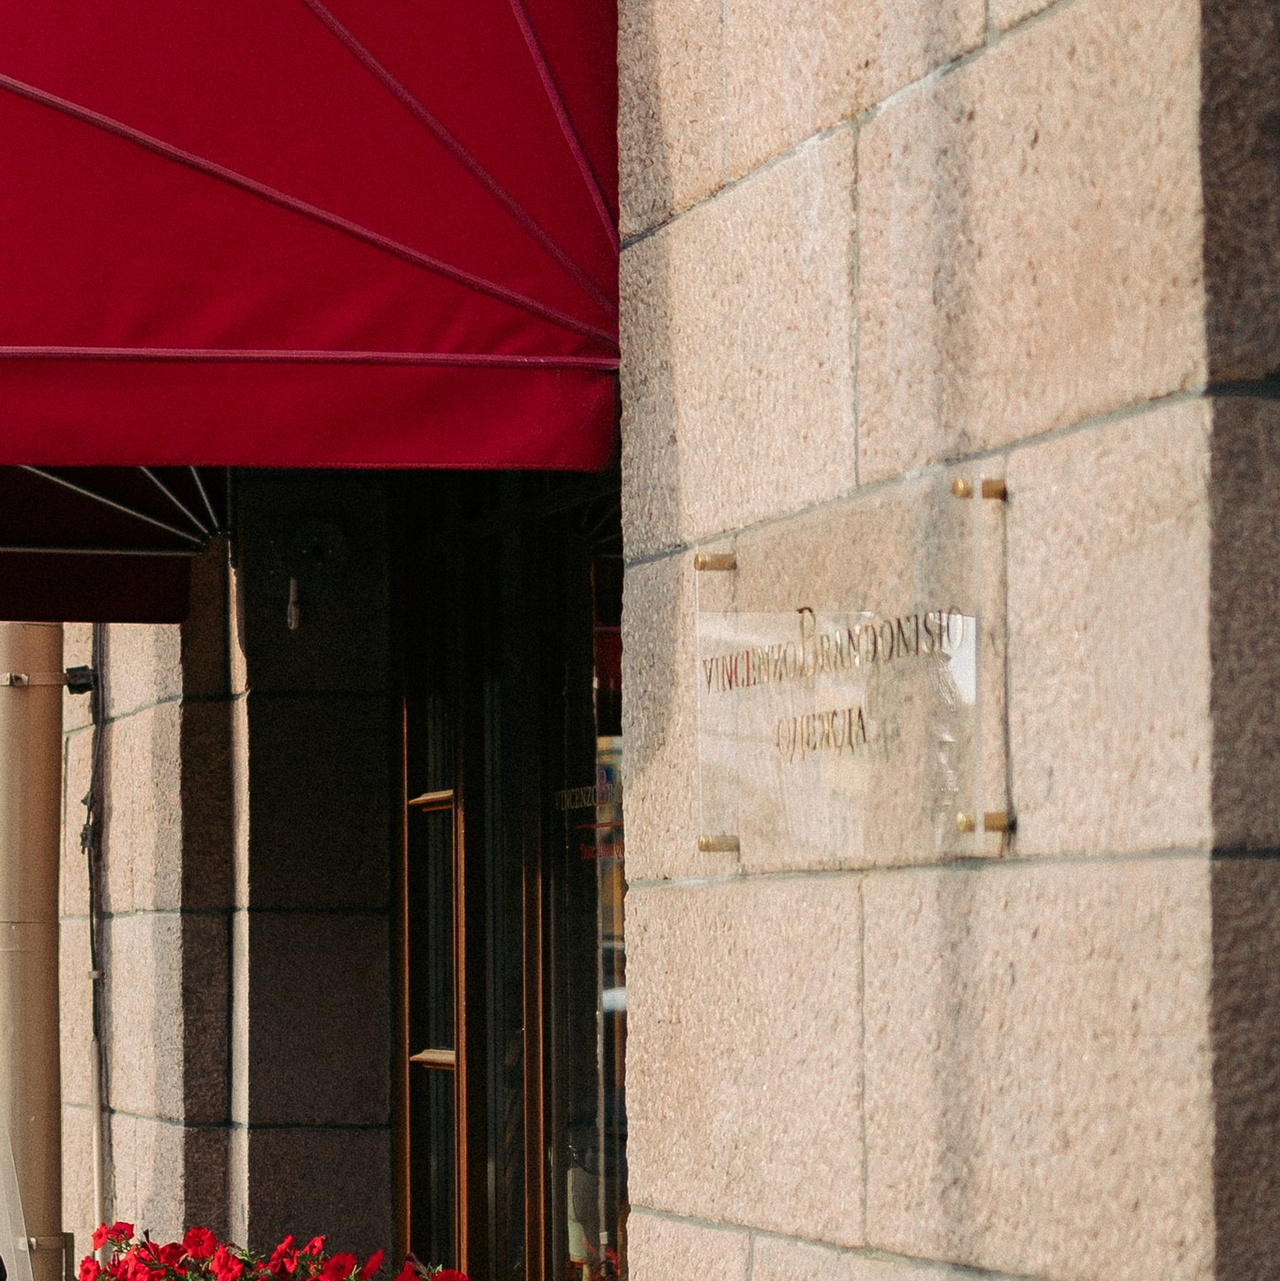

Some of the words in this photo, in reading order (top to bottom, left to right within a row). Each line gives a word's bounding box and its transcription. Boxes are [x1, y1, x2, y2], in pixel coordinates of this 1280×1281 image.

[702, 641, 795, 694] VINCENZO
[797, 605, 964, 678] BRANDONISIO
[776, 706, 867, 763] ОДЕЖДА
